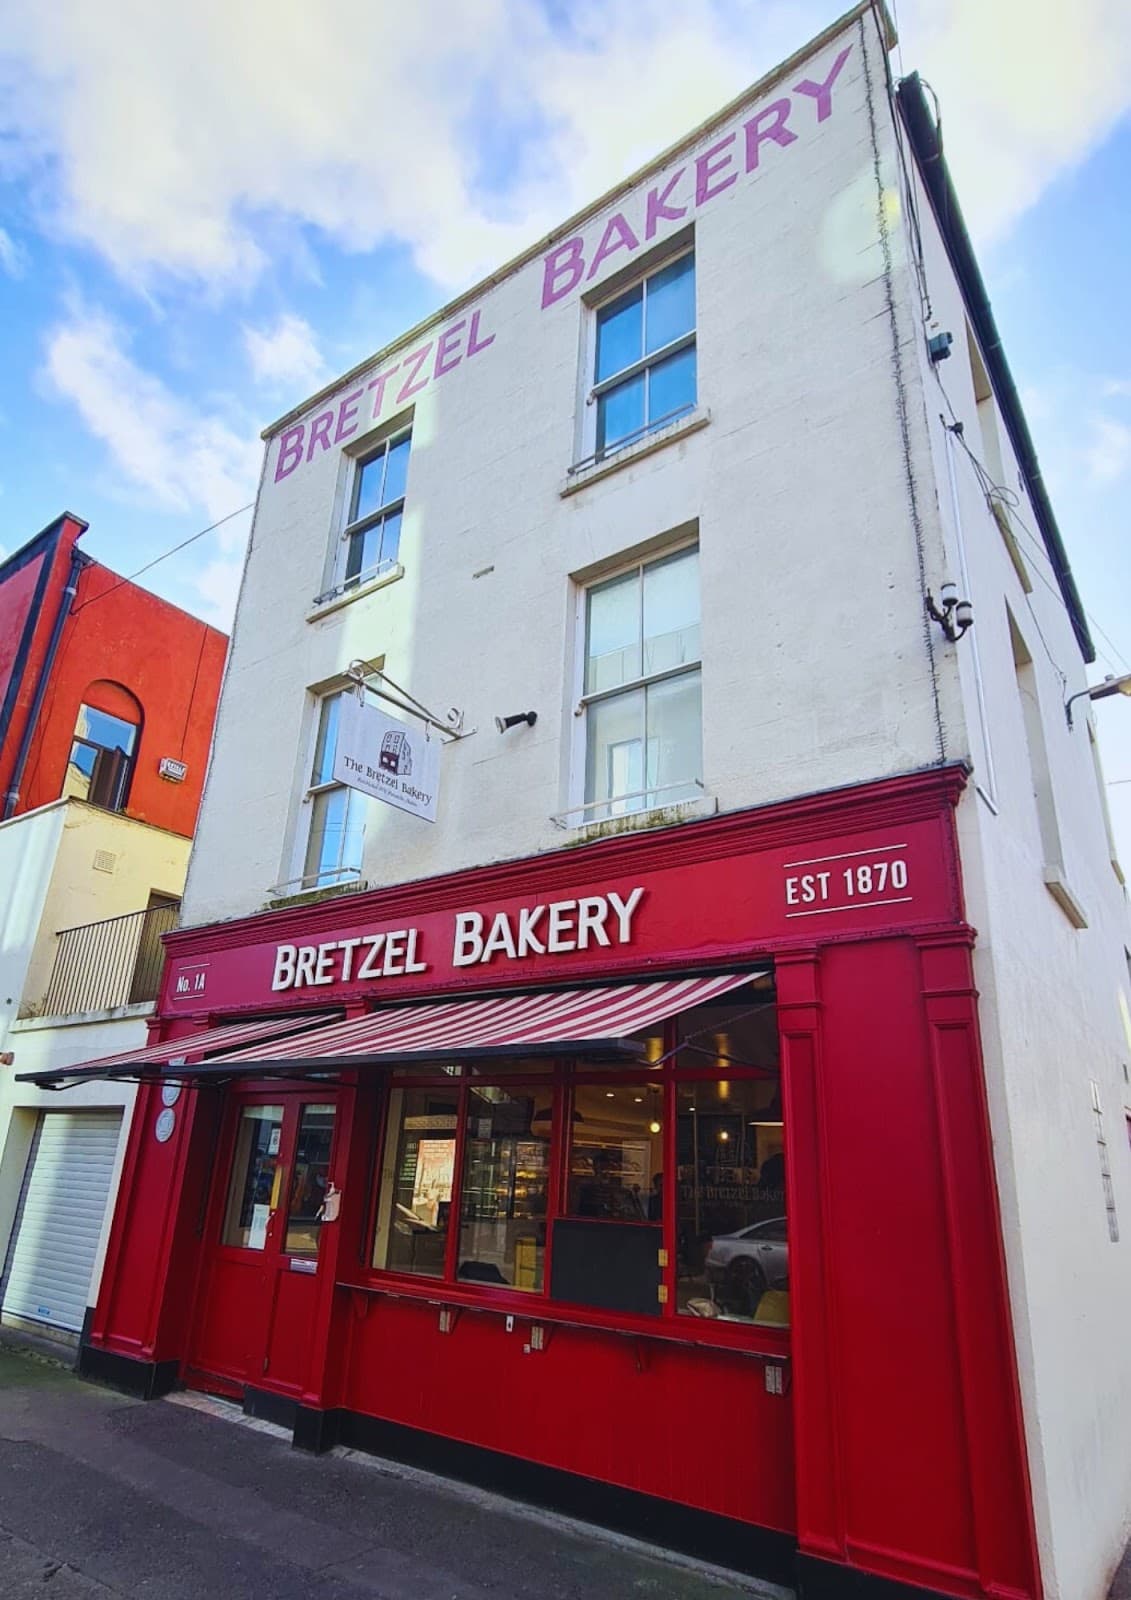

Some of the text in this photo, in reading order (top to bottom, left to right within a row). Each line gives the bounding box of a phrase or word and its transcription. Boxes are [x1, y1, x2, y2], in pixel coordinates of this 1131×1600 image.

[274, 43, 854, 484] BRETZEL BAKERY
[344, 756, 363, 773] The
[366, 766, 398, 789] Bretzel
[402, 782, 432, 806] Bakery
[786, 860, 908, 905] EST 1870
[271, 887, 645, 992] BRETZEL BAKERY
[176, 972, 206, 993] No. 1A
